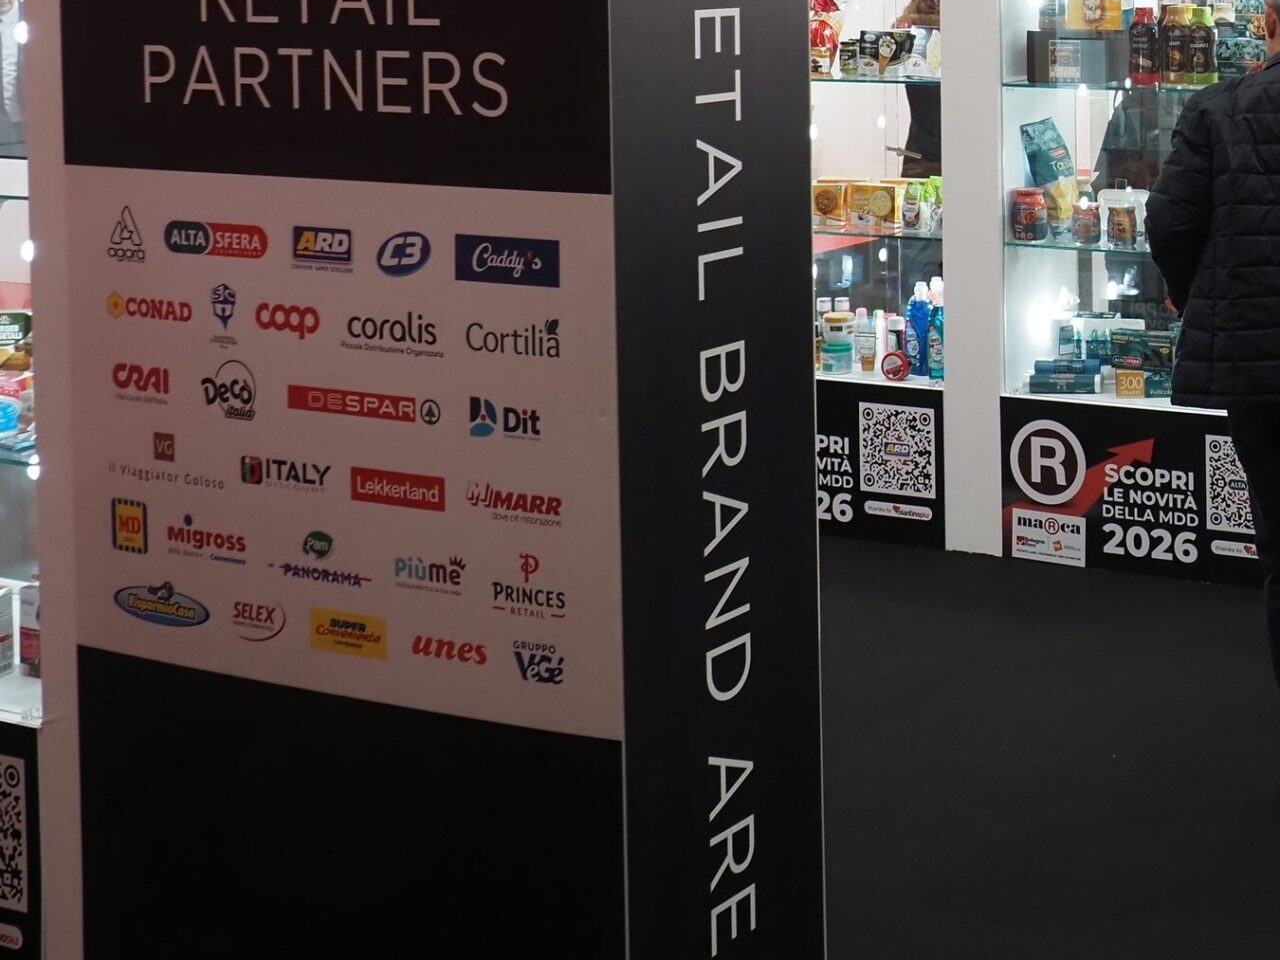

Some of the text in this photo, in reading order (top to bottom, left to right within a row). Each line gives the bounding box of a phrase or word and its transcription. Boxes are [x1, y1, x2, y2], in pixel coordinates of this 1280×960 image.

[143, 45, 508, 118] PARTNERS
[108, 245, 145, 261] agorà
[171, 229, 261, 250] ALTA SFERA
[296, 231, 349, 253] ARD
[380, 236, 423, 266] C3
[472, 243, 541, 277] Caddy's
[125, 297, 192, 322] CONAD
[255, 302, 320, 340] coop
[347, 311, 437, 345] coralis
[466, 319, 560, 358] Cortilia
[113, 362, 169, 394] CRAI
[1120, 377, 1143, 390] 300
[307, 391, 414, 418] DESPAR
[503, 407, 540, 435] Dit
[156, 439, 173, 456] VG
[817, 434, 849, 455] PRI
[886, 443, 909, 453] ARD
[120, 464, 179, 482] Viaggiator
[184, 474, 224, 490] Goloso
[265, 458, 332, 486] ITALY
[819, 473, 853, 488] MDD
[1104, 463, 1194, 490] SCOPRI
[357, 476, 439, 503] Lekkerland
[492, 488, 562, 516] MARR
[1104, 487, 1197, 510] LE NOVITÀ
[817, 490, 853, 522] 26
[1103, 505, 1198, 527] DELLA MDD
[118, 514, 141, 535] MD
[167, 514, 247, 553] Migross
[700, 340, 750, 701] BRAND
[308, 538, 328, 551] Pam
[1102, 523, 1198, 563] 2026
[283, 562, 362, 587] PANORAMA
[492, 582, 565, 609] PRINCES
[233, 601, 275, 625] SELEX
[510, 607, 545, 620] RETAIL
[412, 636, 488, 665] unes
[513, 640, 556, 655] GRUPPO
[708, 756, 756, 958] ARE
